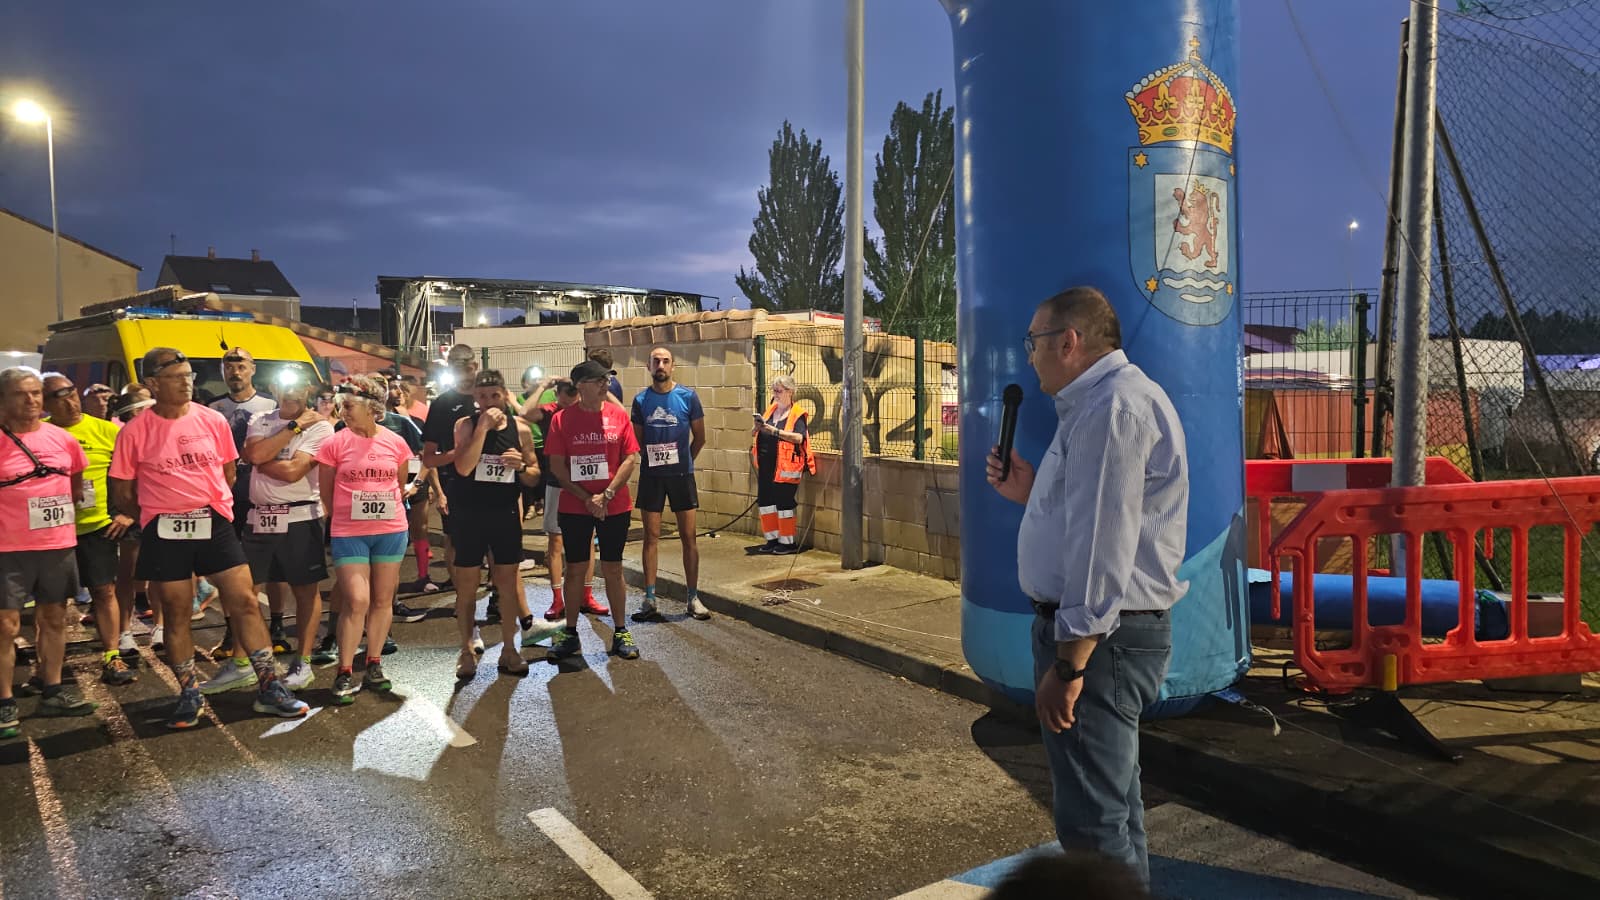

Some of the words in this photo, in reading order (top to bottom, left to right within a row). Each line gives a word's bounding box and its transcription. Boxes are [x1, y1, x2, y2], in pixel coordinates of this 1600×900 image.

[655, 452, 671, 461] 322
[486, 464, 505, 477] 312
[580, 464, 599, 476] 307
[362, 502, 385, 514] 302
[43, 507, 65, 522] 301
[173, 520, 196, 532] 311
[260, 515, 277, 527] 314
